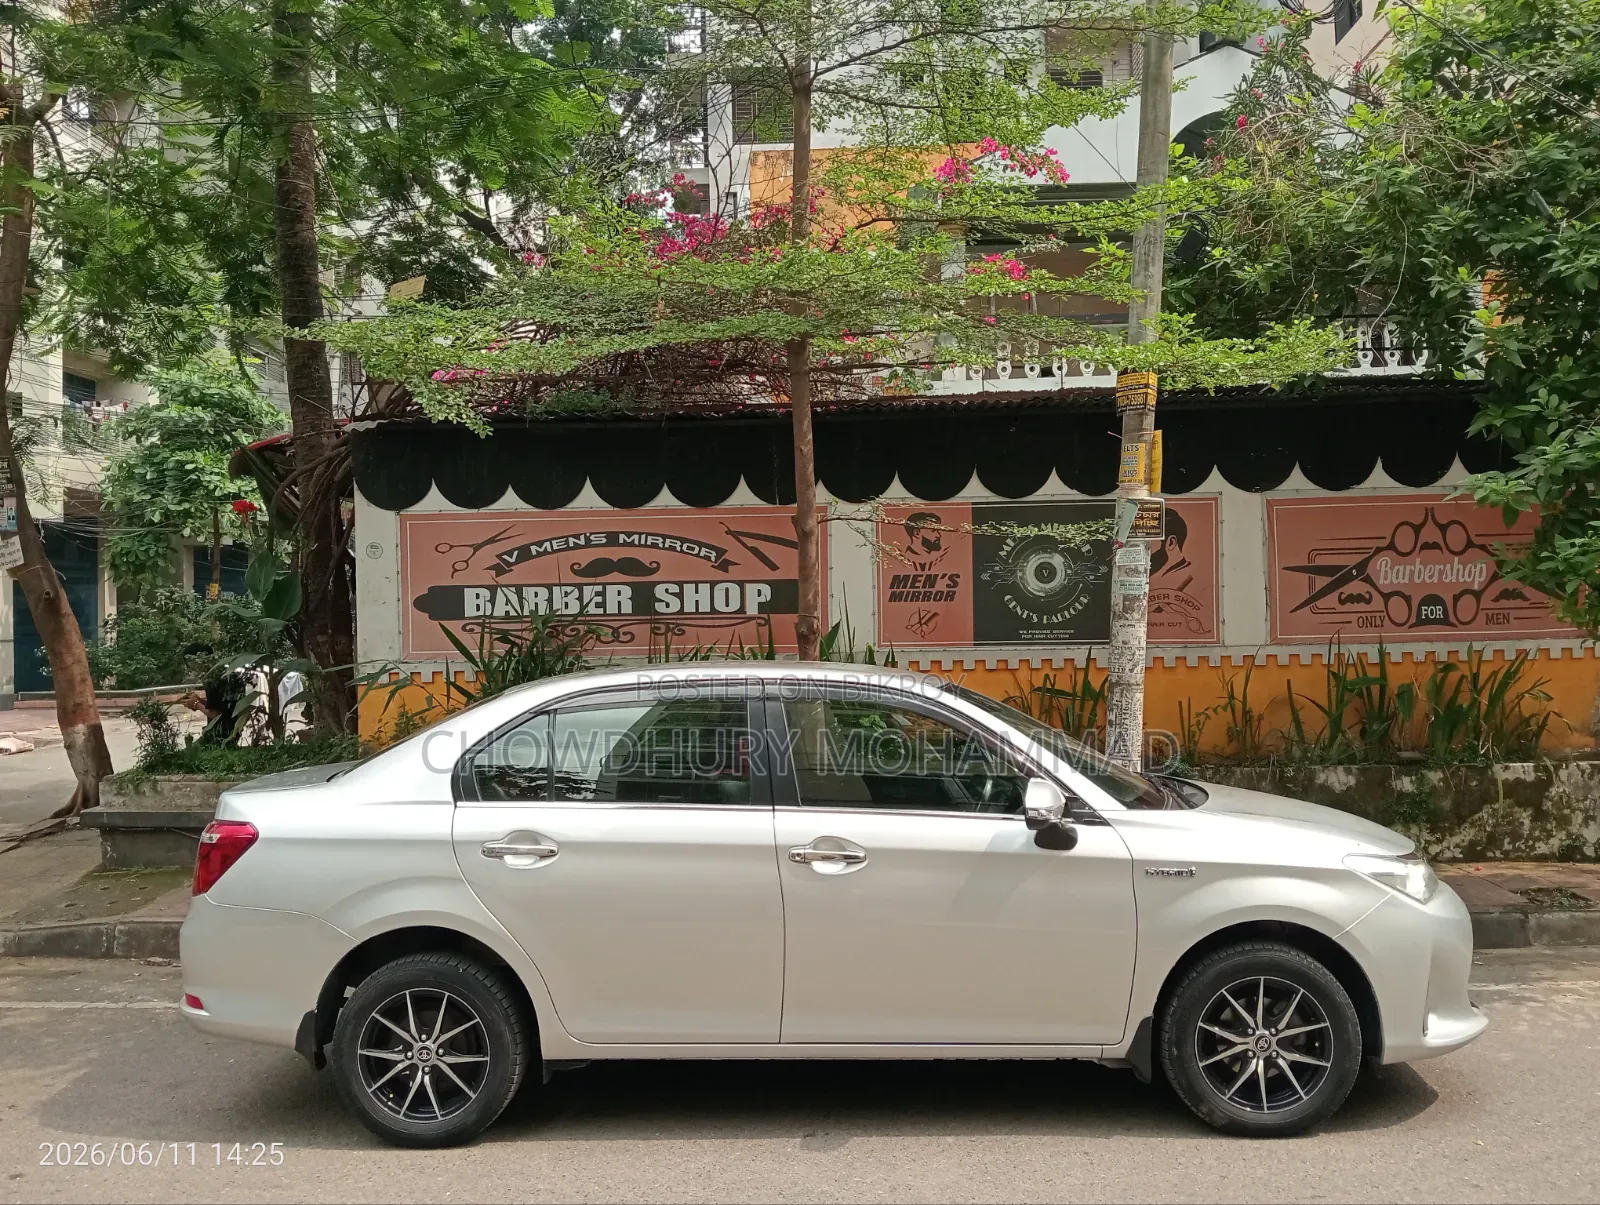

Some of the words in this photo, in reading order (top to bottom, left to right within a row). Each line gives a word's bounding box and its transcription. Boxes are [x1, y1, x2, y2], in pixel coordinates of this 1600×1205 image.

[502, 550, 519, 563] V
[530, 532, 607, 555] MEN'S
[618, 533, 717, 562] MIRROR
[1376, 556, 1487, 589] Barbershop
[889, 573, 961, 590] MEN'S
[464, 584, 633, 618] BARBER
[654, 582, 773, 615] SHOP
[888, 590, 957, 603] MIRROR
[1174, 594, 1201, 611] SHOP
[1004, 595, 1038, 623] GENT'S
[1043, 593, 1090, 624] PARLOUR
[1421, 605, 1444, 619] FOR
[1356, 615, 1386, 629] ONLY
[1485, 612, 1511, 626] MEN
